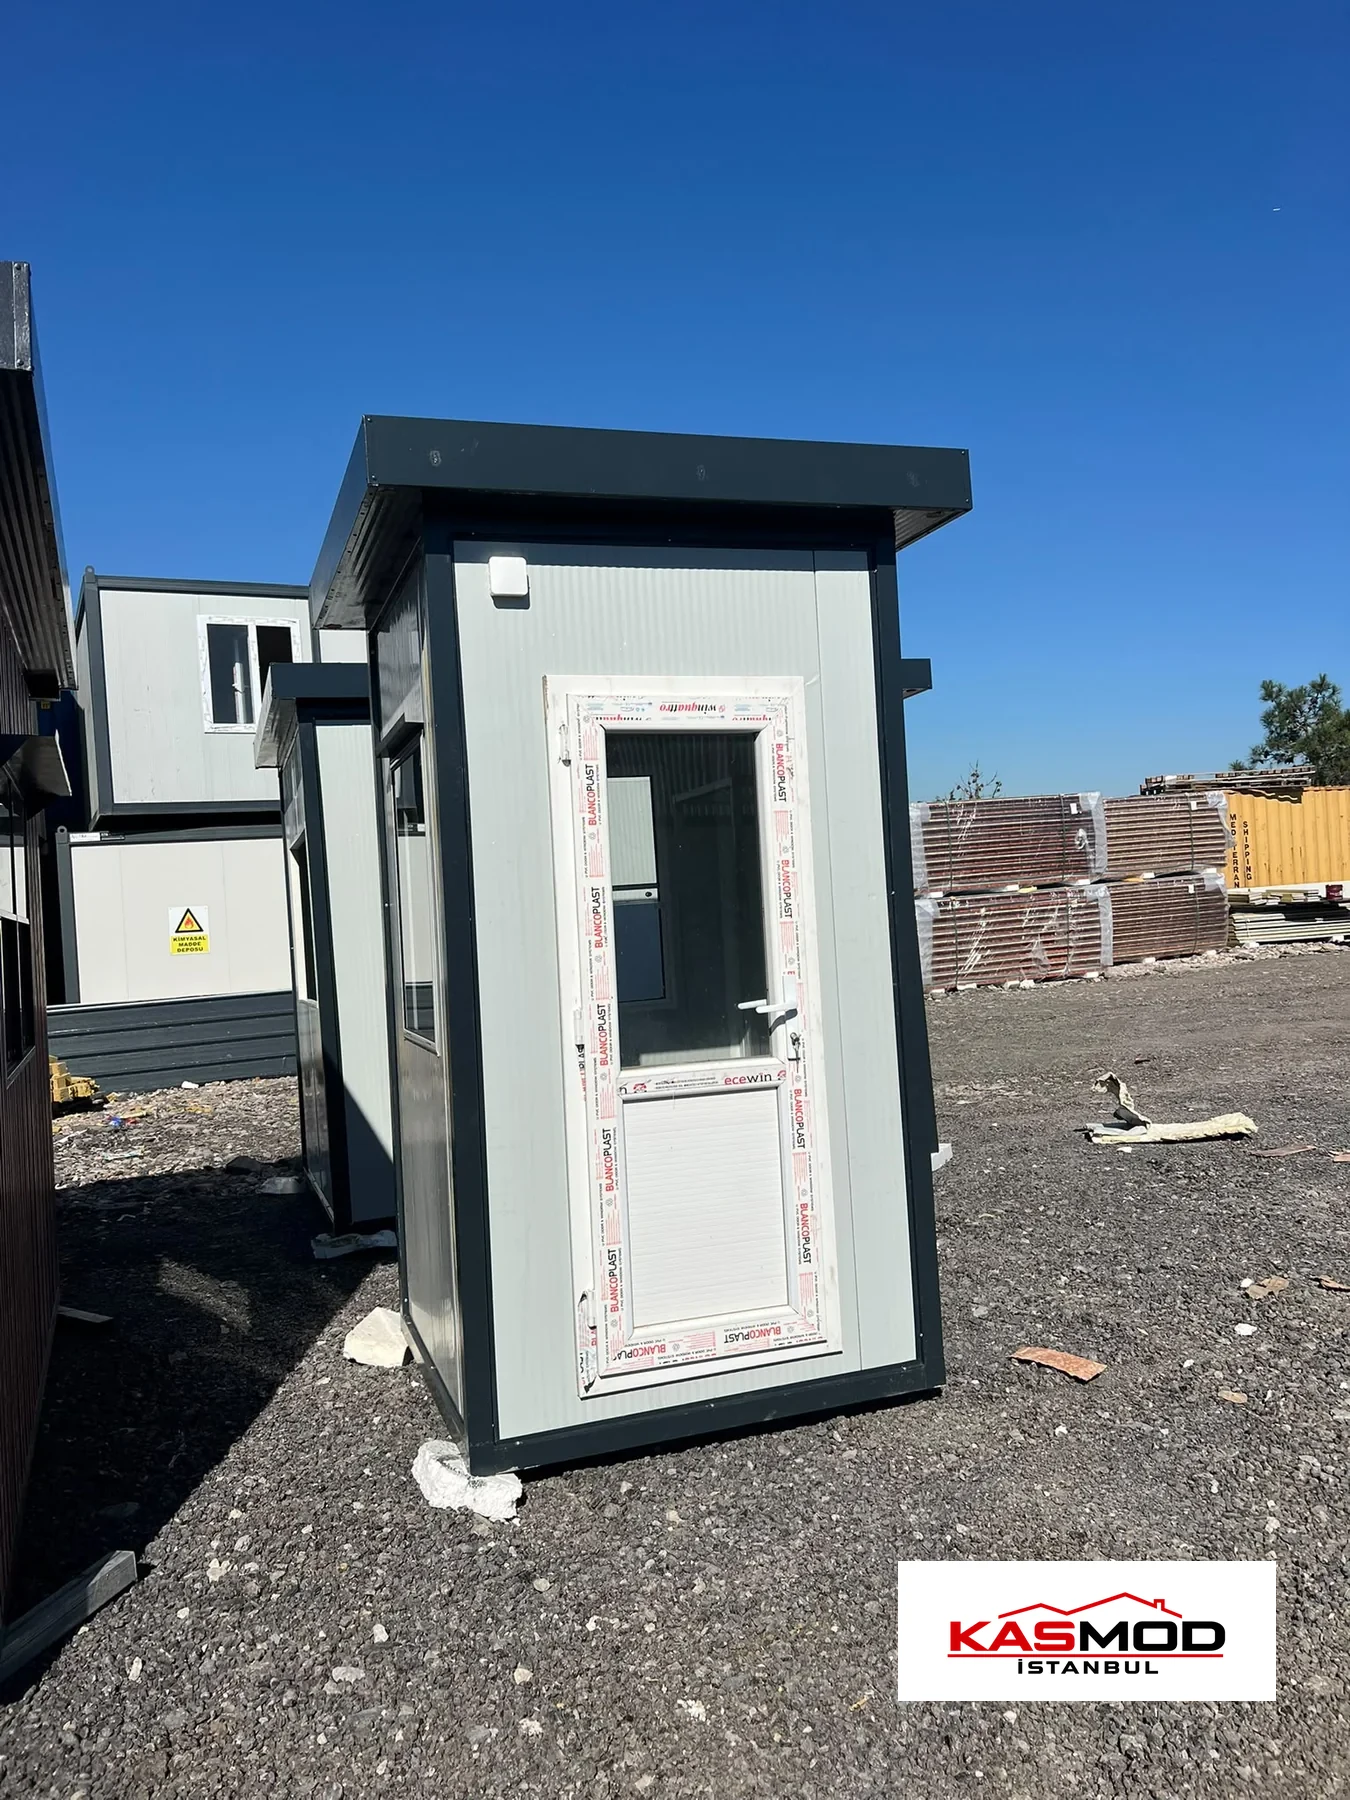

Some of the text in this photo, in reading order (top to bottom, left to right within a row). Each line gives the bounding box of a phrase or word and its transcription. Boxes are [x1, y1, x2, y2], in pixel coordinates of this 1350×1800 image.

[585, 764, 597, 826] BLANCOPLAST
[775, 743, 787, 803] BLANCOPLAST
[1242, 821, 1252, 880] SHIPPING
[591, 886, 604, 949] BLANCOPLAST
[781, 859, 793, 919] BLANCOPLAST
[597, 1003, 609, 1066] BLANCOPLAST
[724, 1072, 772, 1086] ecewin
[793, 1088, 806, 1149] BLANCOPLAST
[602, 1128, 615, 1192] BLANCOPLAST
[800, 1202, 812, 1264] BLANCOPLAST
[607, 1248, 620, 1313] BLANCOPLAST
[724, 1326, 782, 1343] BLANCOPLAST
